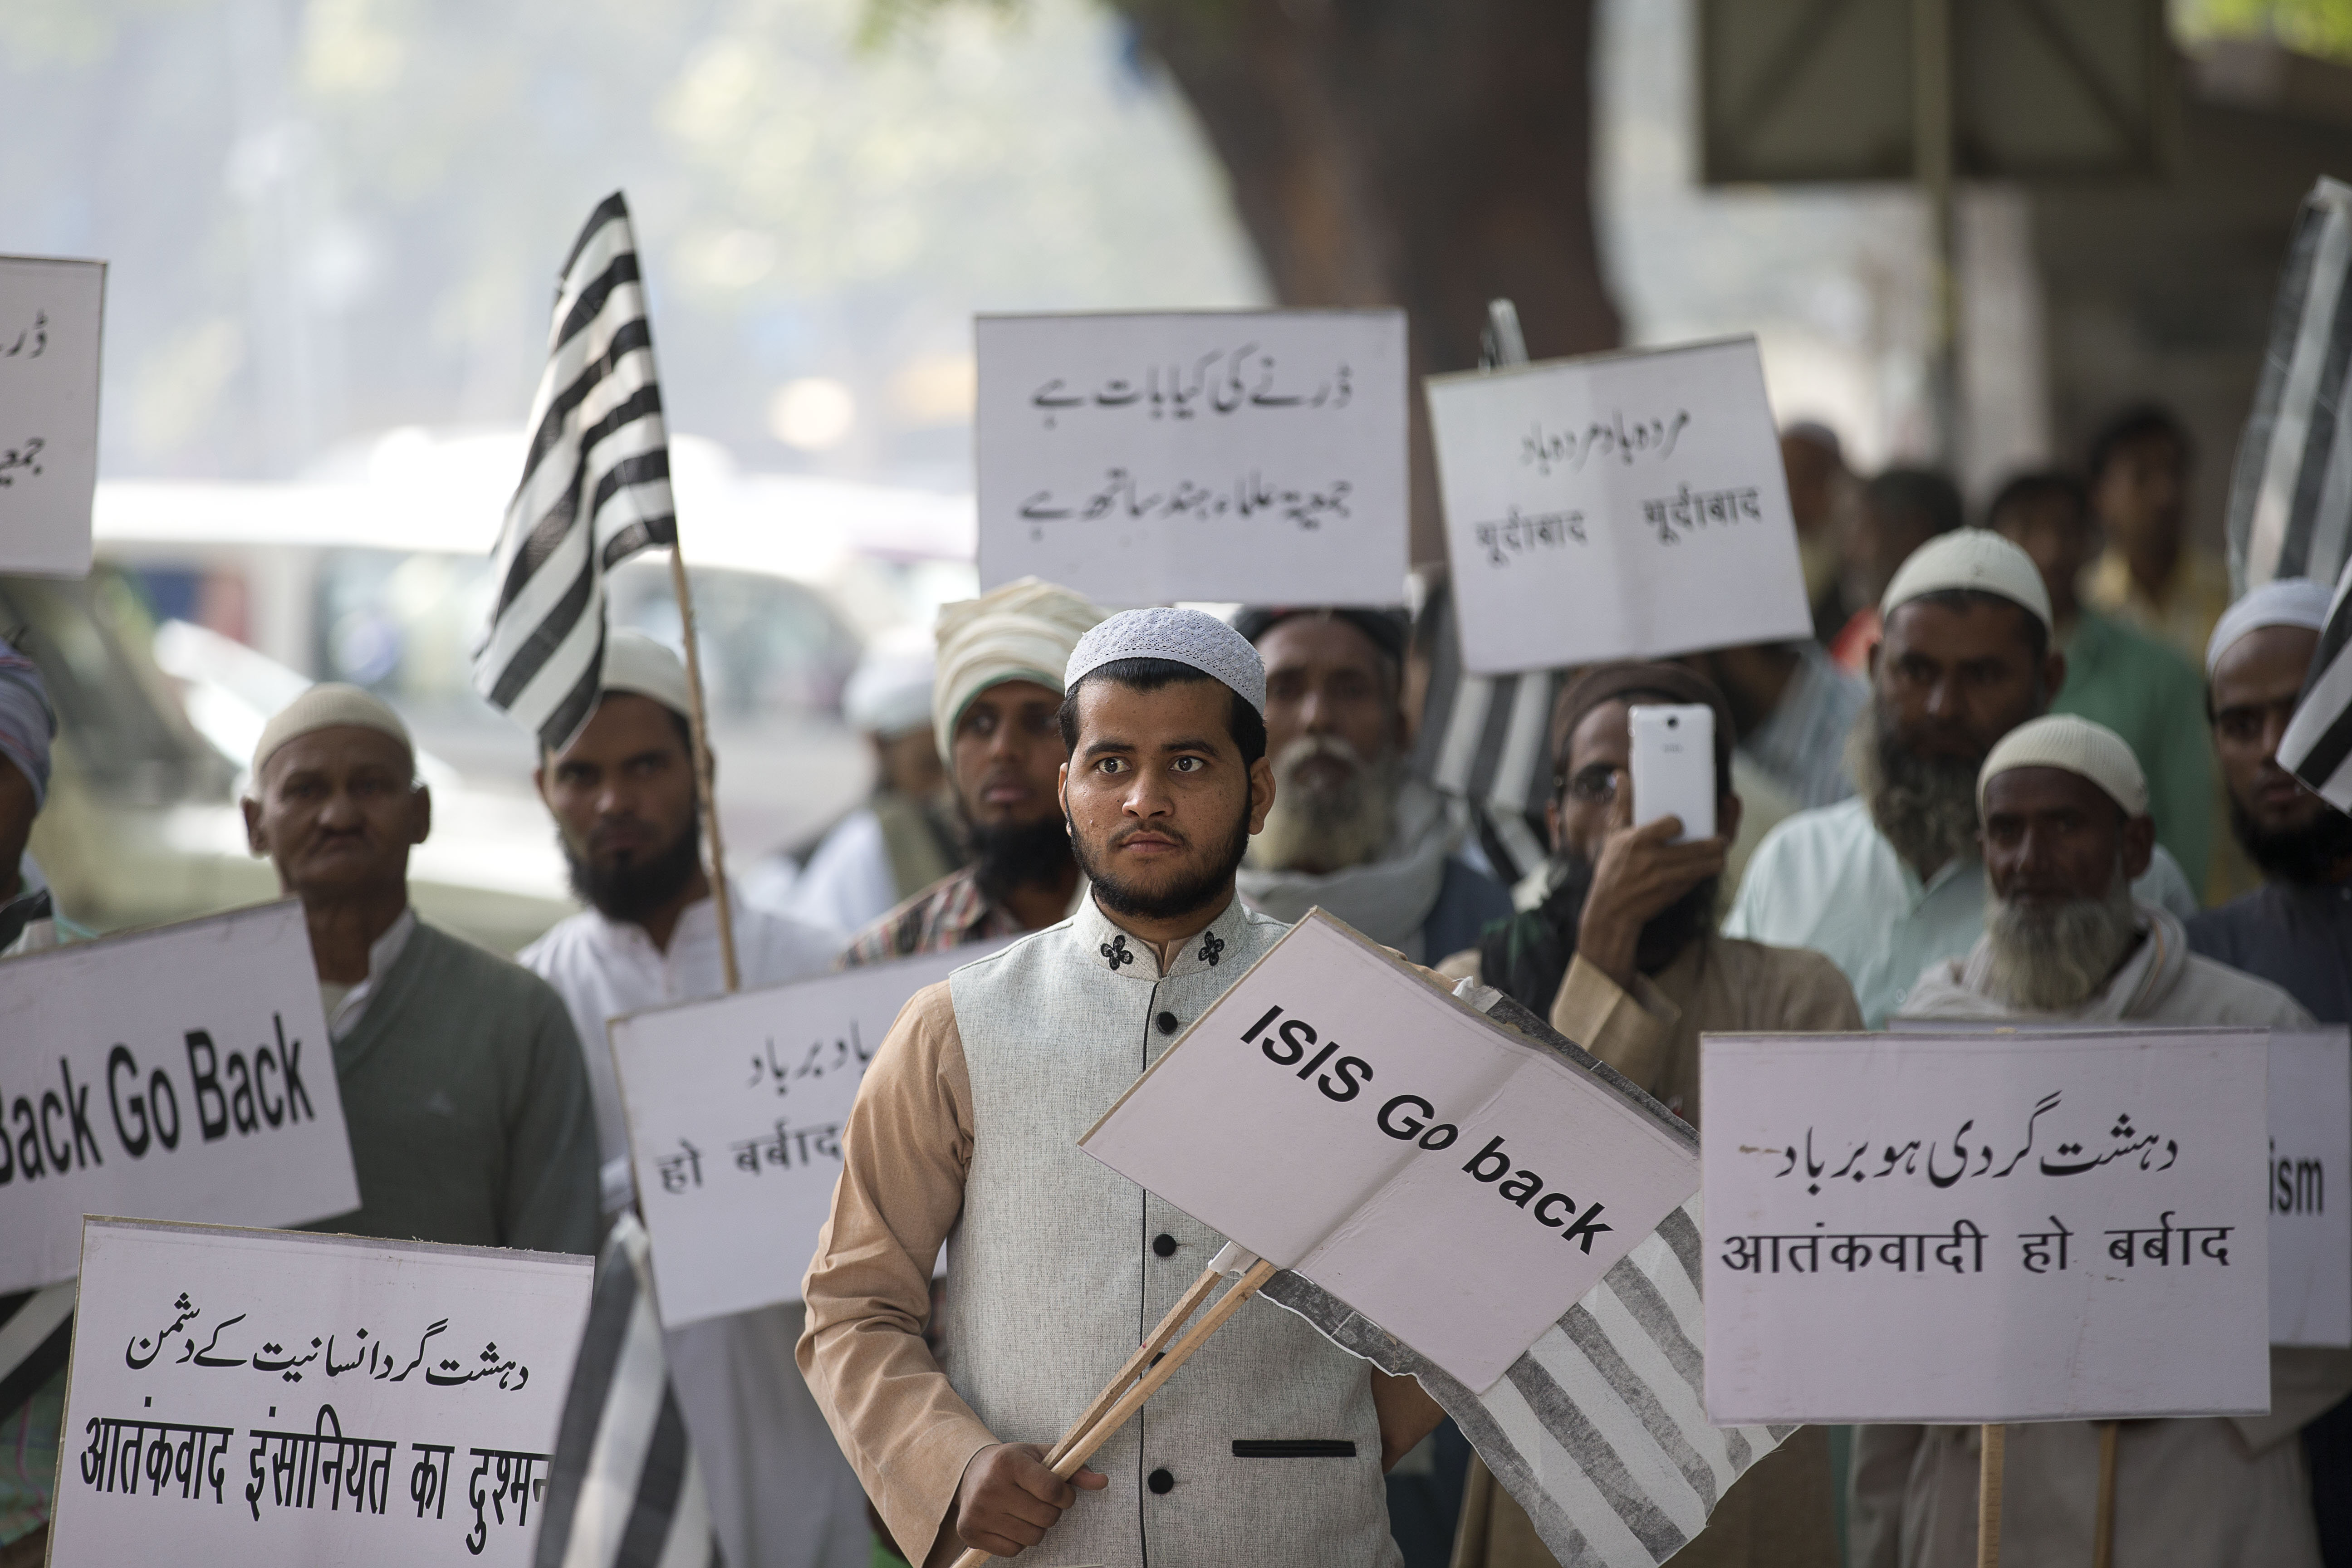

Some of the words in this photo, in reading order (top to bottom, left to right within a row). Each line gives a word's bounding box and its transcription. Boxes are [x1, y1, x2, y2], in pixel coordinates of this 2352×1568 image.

[1032, 377, 1084, 428] ہے
[1019, 490, 1073, 543] ہے
[107, 1043, 179, 1160] Go
[185, 1011, 315, 1144] Back
[656, 1137, 704, 1195] हो
[728, 1116, 844, 1176] बर्बाद
[1240, 1004, 1374, 1102] ISIS
[1377, 1094, 1459, 1152] Go
[1461, 1136, 1614, 1256] back
[2039, 1113, 2178, 1176] دہشت
[2269, 1137, 2324, 1216] ism
[1721, 1219, 1989, 1274] आतंकवादी
[2020, 1215, 2073, 1273] हो
[2105, 1211, 2235, 1267] बर्बाद
[125, 1292, 201, 1370] دشمن
[193, 1313, 247, 1367] کے
[425, 1342, 529, 1391] دہشت
[80, 1396, 234, 1504] आतंकवाद
[245, 1404, 397, 1522] इंसानियत
[410, 1443, 455, 1520] का
